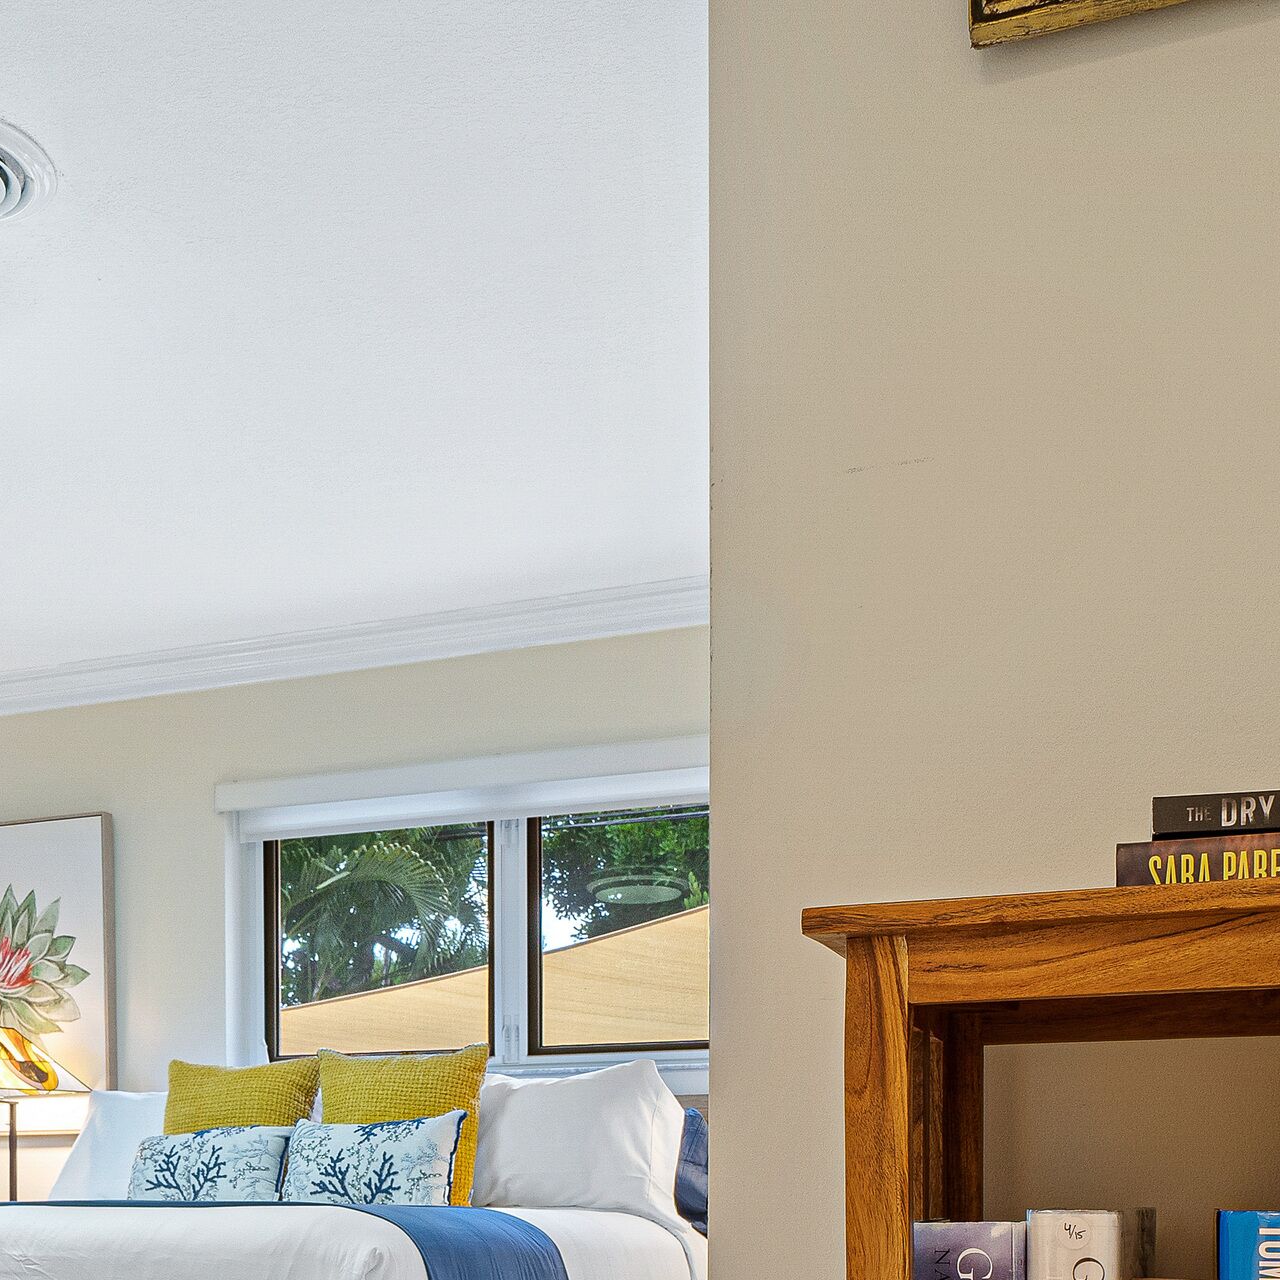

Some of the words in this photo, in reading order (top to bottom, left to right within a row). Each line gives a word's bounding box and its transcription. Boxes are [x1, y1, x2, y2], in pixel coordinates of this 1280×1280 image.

[1186, 807, 1211, 822] THE
[1222, 795, 1275, 827] DRY
[1149, 852, 1210, 885] SARA
